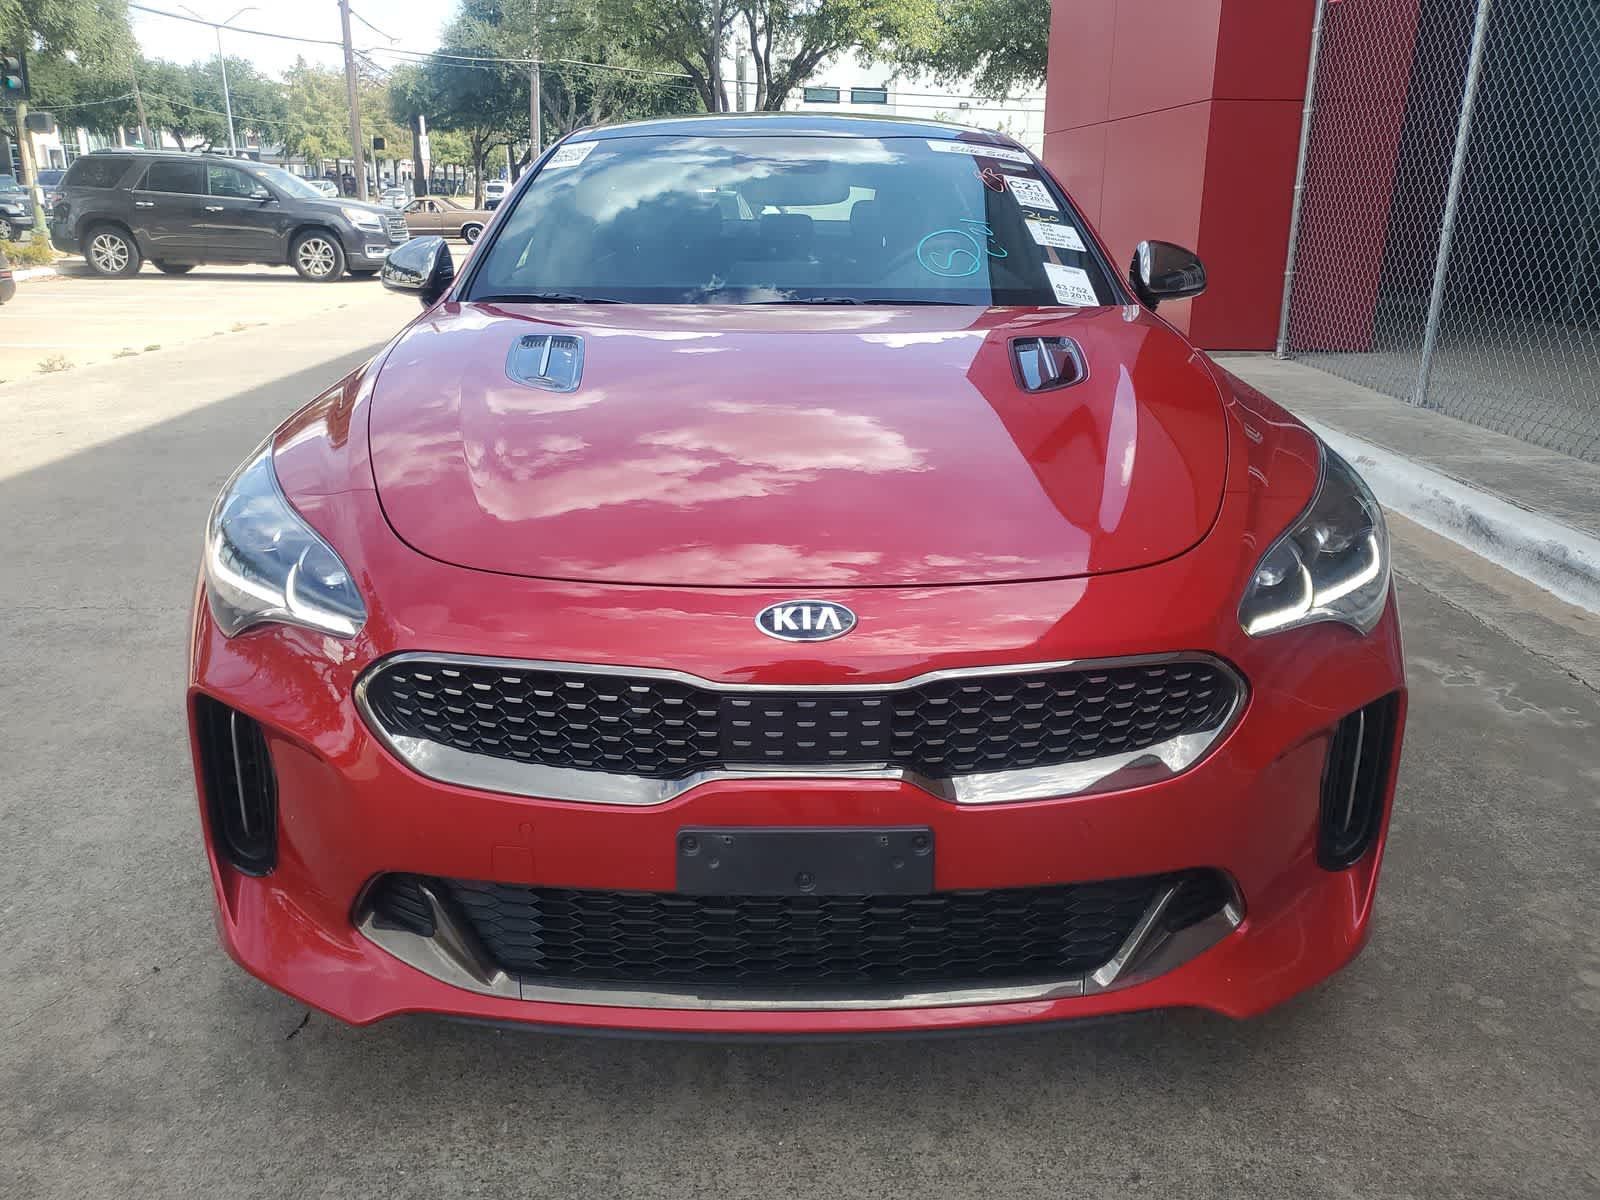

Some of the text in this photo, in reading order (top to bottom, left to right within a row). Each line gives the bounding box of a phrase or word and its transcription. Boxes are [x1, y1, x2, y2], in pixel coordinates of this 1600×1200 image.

[1009, 180, 1042, 193] C21
[1070, 292, 1094, 302] 2018
[773, 606, 842, 631] KIA
